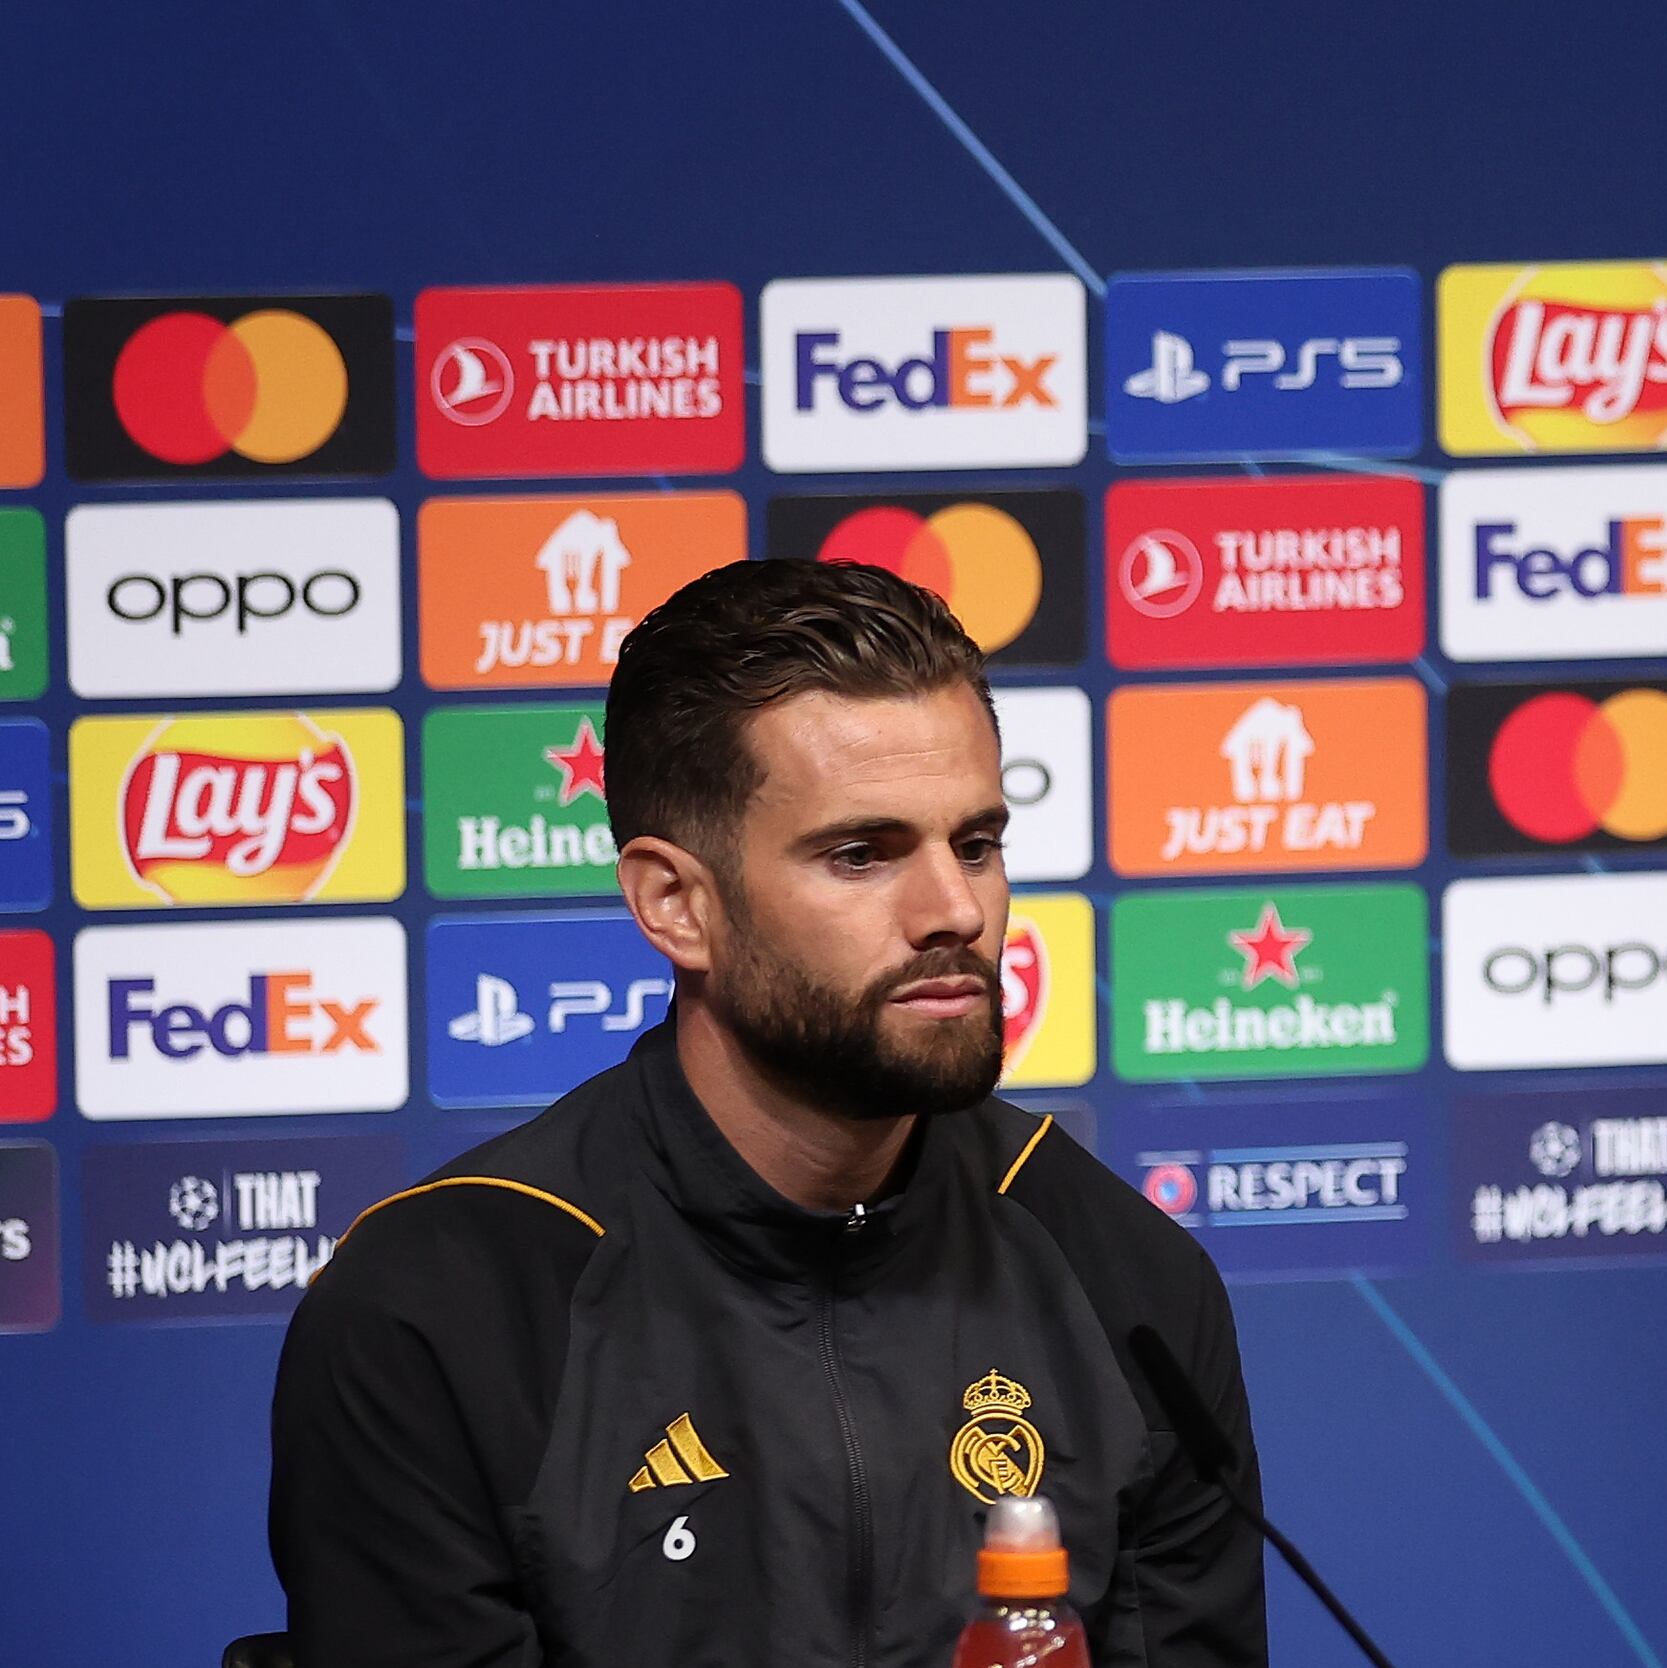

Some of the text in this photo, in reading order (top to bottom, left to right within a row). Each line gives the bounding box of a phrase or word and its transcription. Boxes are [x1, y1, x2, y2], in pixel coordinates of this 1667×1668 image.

[529, 337, 720, 377] TURKISH
[795, 325, 1060, 415] FedEx
[1222, 337, 1405, 392] PS5
[527, 381, 723, 422] AIRLINES
[1213, 527, 1401, 573] TURKISH
[107, 569, 361, 636] oppo
[1213, 569, 1405, 614] AIRLINES
[475, 625, 585, 675] JUST
[137, 749, 341, 876] Lay's
[1162, 802, 1377, 860] JUST EAT
[457, 818, 617, 870] Heine
[107, 969, 381, 1062] FedEx
[550, 981, 672, 1032] PS
[1145, 992, 1396, 1055] Heineken
[235, 1172, 322, 1229] THAT
[1208, 1158, 1406, 1212] RESPECT
[662, 1515, 696, 1561] 6
